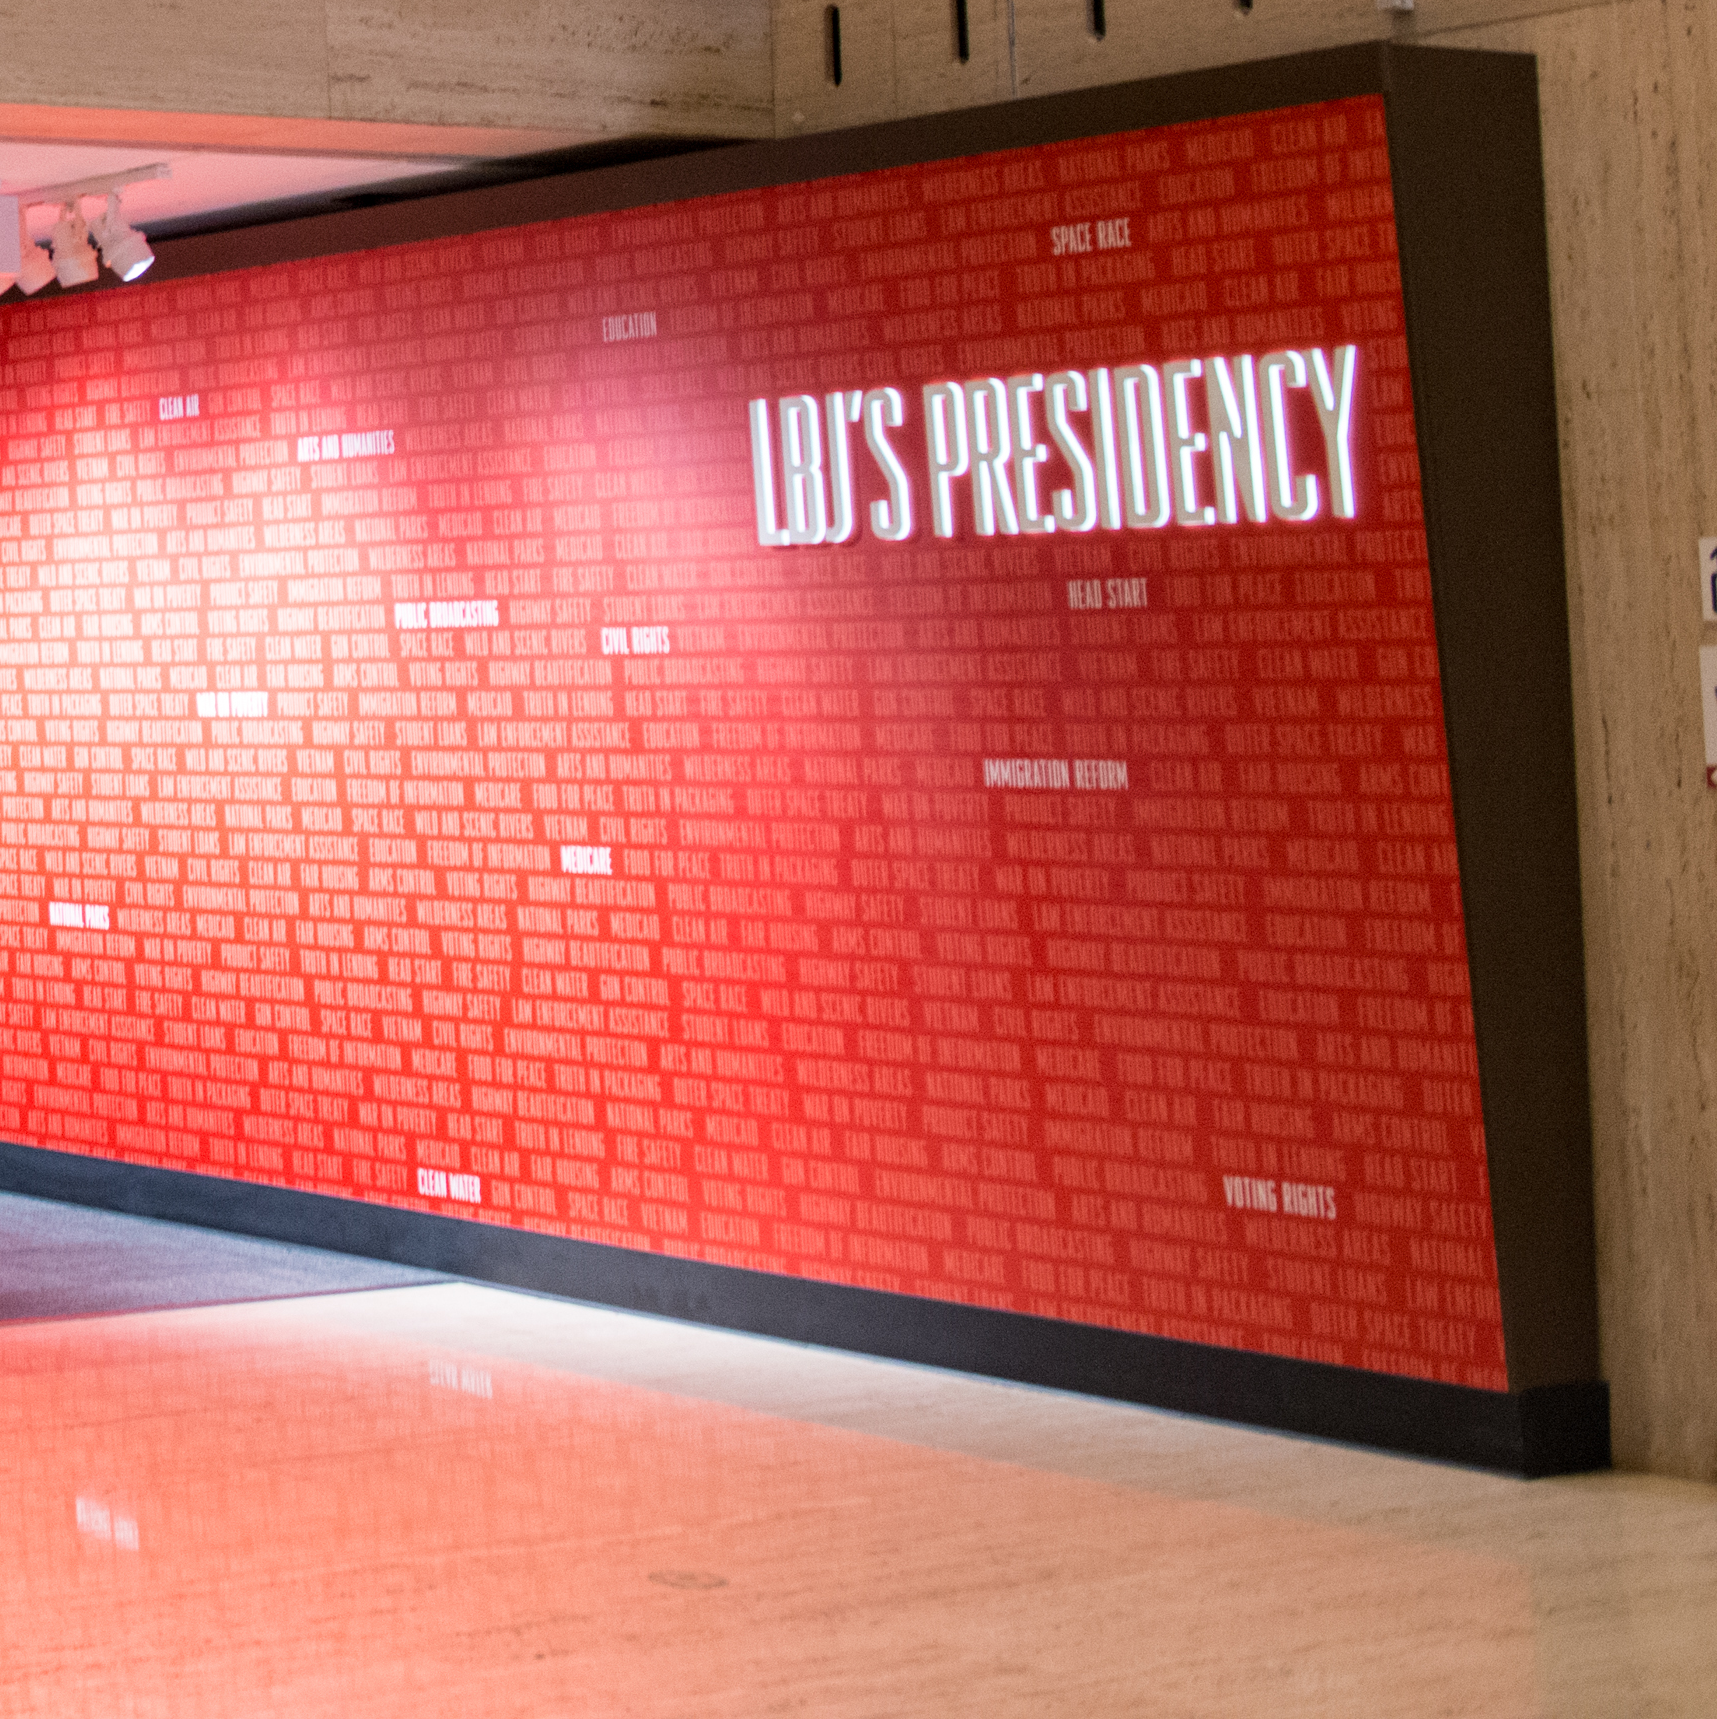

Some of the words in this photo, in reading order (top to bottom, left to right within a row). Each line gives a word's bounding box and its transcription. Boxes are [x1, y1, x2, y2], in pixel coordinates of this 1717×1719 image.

[1049, 224, 1093, 259] SPACE
[1096, 219, 1132, 253] RACE
[601, 311, 658, 344] EDUCATION
[158, 395, 183, 420] CLEAN
[185, 393, 200, 417] AIR
[296, 436, 320, 462] ARTS
[321, 434, 339, 460] AND
[340, 429, 395, 458] HUMANITIES
[749, 386, 912, 548] LBJ'S
[923, 344, 1358, 540] PRESIDENCY
[1066, 580, 1103, 611] HEAD
[1105, 578, 1150, 610] START
[393, 603, 427, 628] PUBLIC
[429, 600, 500, 628] BROADCASTING
[600, 627, 629, 654] CIVIL
[630, 626, 670, 654] RIGHTS
[195, 692, 216, 716] WAR
[217, 692, 230, 716] ON
[230, 692, 269, 716] POVERTY
[18, 745, 41, 767] CLEAN
[42, 745, 67, 768] WATER
[73, 746, 89, 768] GUN
[90, 746, 123, 769] CONTROL
[131, 747, 154, 770] SPACE
[156, 747, 176, 770] RACE
[184, 747, 206, 771] WILD
[207, 748, 225, 771] AND
[226, 748, 255, 772] SCENIC
[257, 748, 288, 773] RIVERS
[296, 749, 335, 774] VIETNAM
[342, 750, 366, 775] CIVIL
[368, 750, 402, 775] RIGHTS
[410, 751, 484, 777] ENVIRONMENTAL
[487, 752, 546, 779] PROTECTION
[556, 753, 583, 779] ARTS
[584, 753, 607, 780] AND
[608, 753, 673, 781] HUMANITIES
[682, 754, 752, 783] WILDERNESS
[754, 755, 792, 784] AREAS
[23, 771, 55, 794] HIGHWAY
[57, 772, 83, 795] SAFETY
[90, 773, 123, 796] STUDENT
[124, 773, 150, 797] LOANS
[157, 774, 175, 798] LAW
[175, 775, 231, 799] ENFORCEMENT
[233, 776, 282, 801] ASSISTANCE
[290, 777, 337, 803] EDUCATION
[982, 759, 1071, 790] IMMIGRATION
[1073, 760, 1130, 792] REFORM
[345, 779, 387, 804] FREEDOM
[388, 780, 400, 805] OF
[402, 780, 465, 807] INFORMATION
[473, 782, 521, 809] MEDICARE
[531, 783, 559, 810] FOOD
[560, 784, 581, 810] FOR
[582, 784, 615, 812] PEACE
[622, 785, 656, 813] TRUTH
[658, 786, 672, 813] IN
[673, 786, 735, 815] PACKAGING
[560, 846, 612, 874] MEDICARE
[181, 884, 246, 912] ENVIRONMENTAL
[248, 888, 300, 916] PROTECTION
[307, 892, 331, 918] ARTS
[332, 893, 351, 919] AND
[352, 895, 407, 923] HUMANITIES
[415, 899, 474, 928] WILDERNESS
[475, 902, 507, 930] AREAS
[48, 902, 84, 927] NATIONAL
[84, 905, 109, 929] PARKS
[515, 905, 562, 934] NATIONAL
[565, 908, 599, 937] PARKS
[609, 911, 661, 941] MEDICAID
[670, 914, 706, 944] CLEAN
[708, 917, 728, 946] AIR
[739, 919, 766, 948] FAIR
[768, 920, 819, 952] HOUSING
[830, 924, 866, 955] ARMS
[868, 927, 922, 959] CONTROL
[220, 942, 257, 969] PRODUCT
[259, 945, 290, 972] SAFETY
[299, 949, 327, 975] TRUTH
[328, 951, 339, 976] IN
[341, 952, 379, 980] LENDING
[387, 956, 412, 983] HEAD
[413, 958, 442, 986] START
[451, 961, 473, 988] FIRE
[475, 963, 512, 992] SAFETY
[520, 966, 552, 995] CLEAN
[554, 969, 589, 999] WATER
[598, 973, 622, 1002] GUN
[623, 975, 670, 1006] CONTROL
[681, 980, 715, 1010] SPACE
[718, 983, 744, 1013] RACE
[416, 1167, 447, 1197] CLEAN
[448, 1172, 481, 1203] WATER
[1222, 1174, 1278, 1213] VOTING
[1280, 1181, 1338, 1221] RIGHTS
